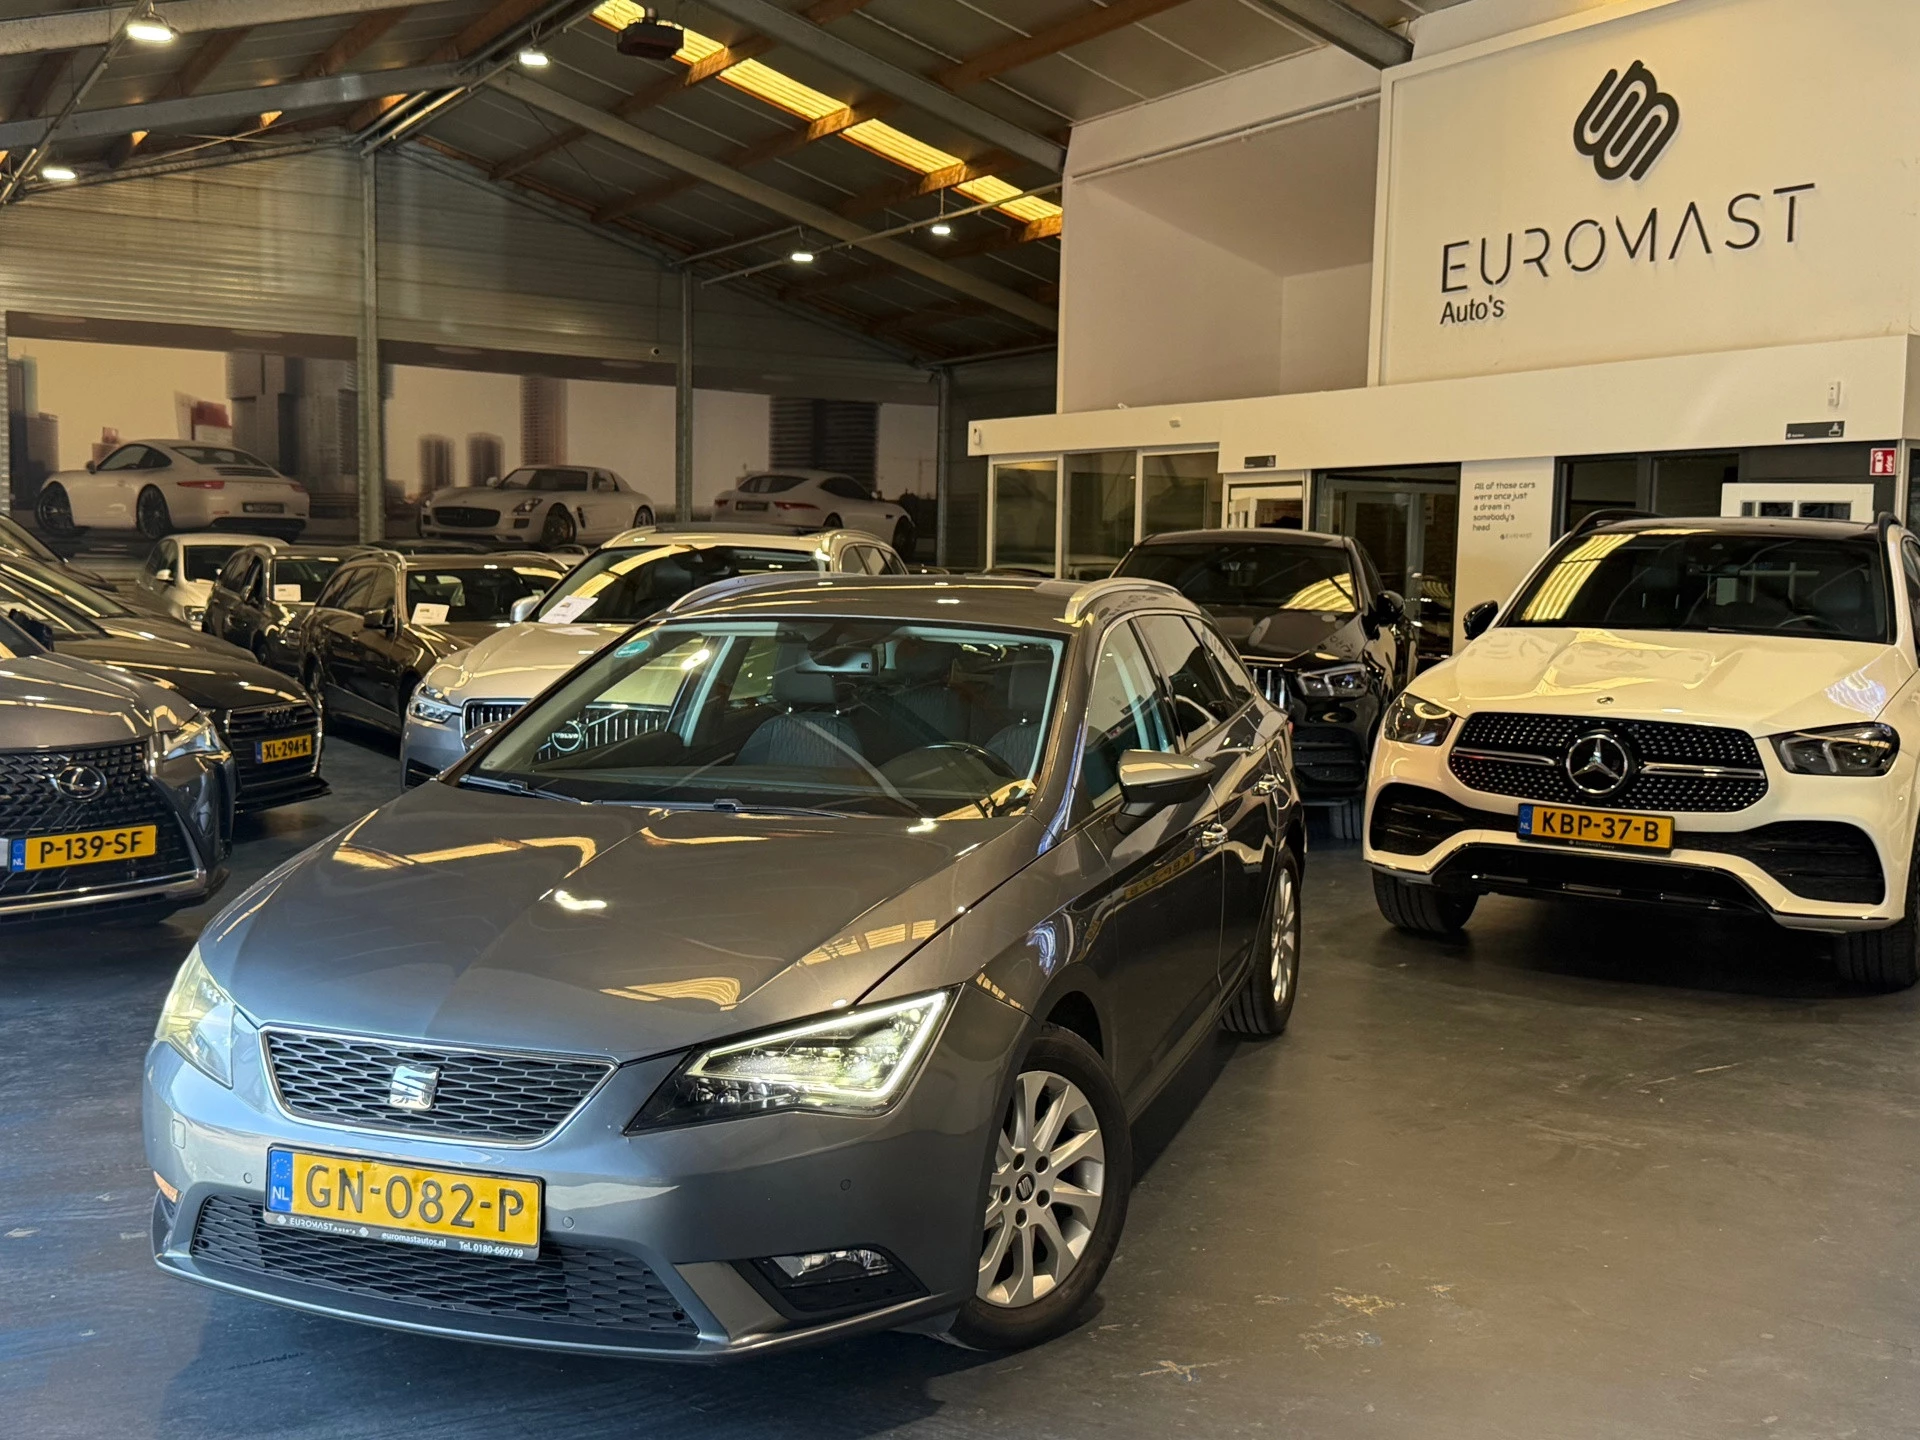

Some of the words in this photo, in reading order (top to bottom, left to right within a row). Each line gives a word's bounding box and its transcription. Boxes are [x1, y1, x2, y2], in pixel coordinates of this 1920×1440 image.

[1440, 182, 1816, 294] EUROMAST
[1439, 294, 1506, 325] Auto's
[1474, 482, 1484, 490] All
[1486, 481, 1495, 490] of
[1511, 492, 1527, 502] just
[1480, 503, 1502, 511] dream
[1472, 523, 1491, 531] head
[265, 738, 309, 760] XL-294-K
[1542, 811, 1659, 842] KBP-37-B
[12, 858, 24, 866] NL
[40, 831, 143, 864] P-139-SF
[272, 1185, 290, 1201] NL
[305, 1164, 525, 1233] GN-082-P
[290, 1217, 334, 1230] EUROMAST
[381, 1231, 447, 1248] euromastautos.nl
[473, 1243, 524, 1258] 0180-669749
